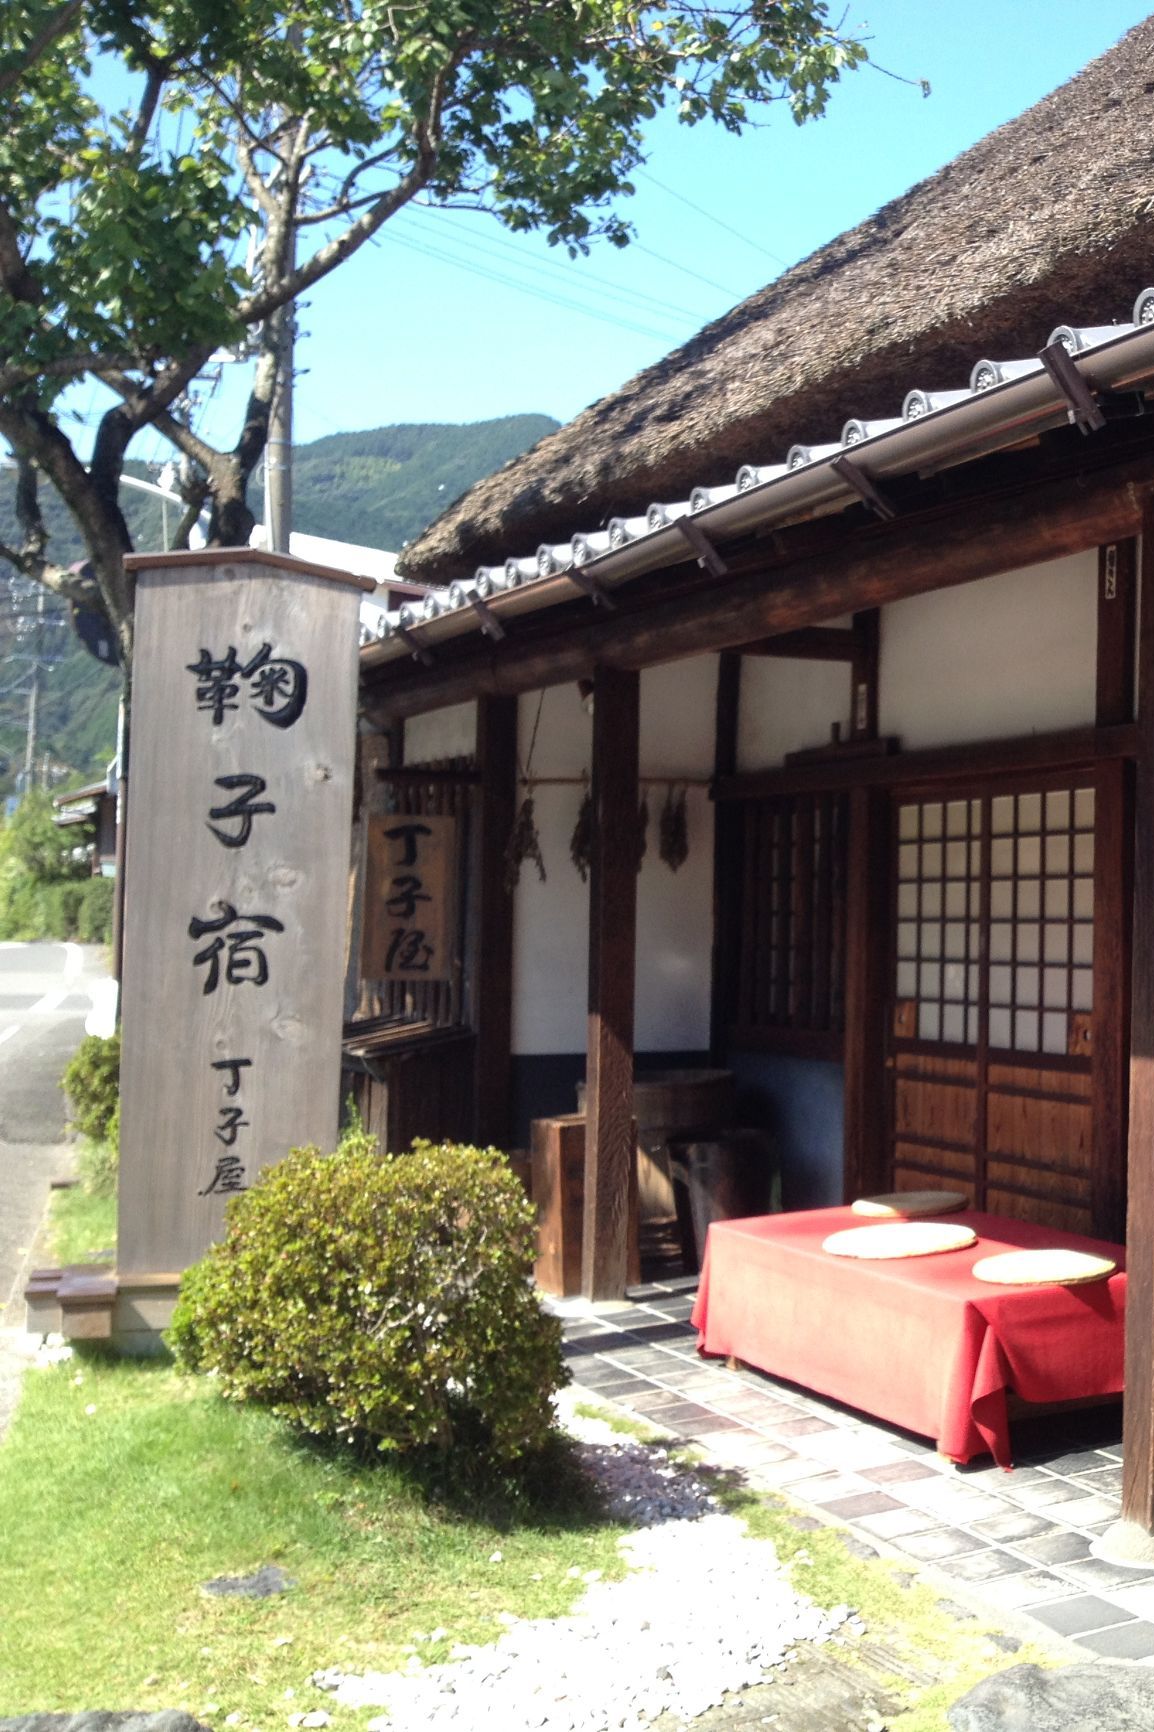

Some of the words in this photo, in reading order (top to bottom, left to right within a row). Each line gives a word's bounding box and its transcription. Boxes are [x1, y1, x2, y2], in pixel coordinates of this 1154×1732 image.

[186, 641, 308, 996] 鞠子宿
[383, 822, 434, 974] 丁子屋
[196, 1057, 252, 1196] 丁子屋
